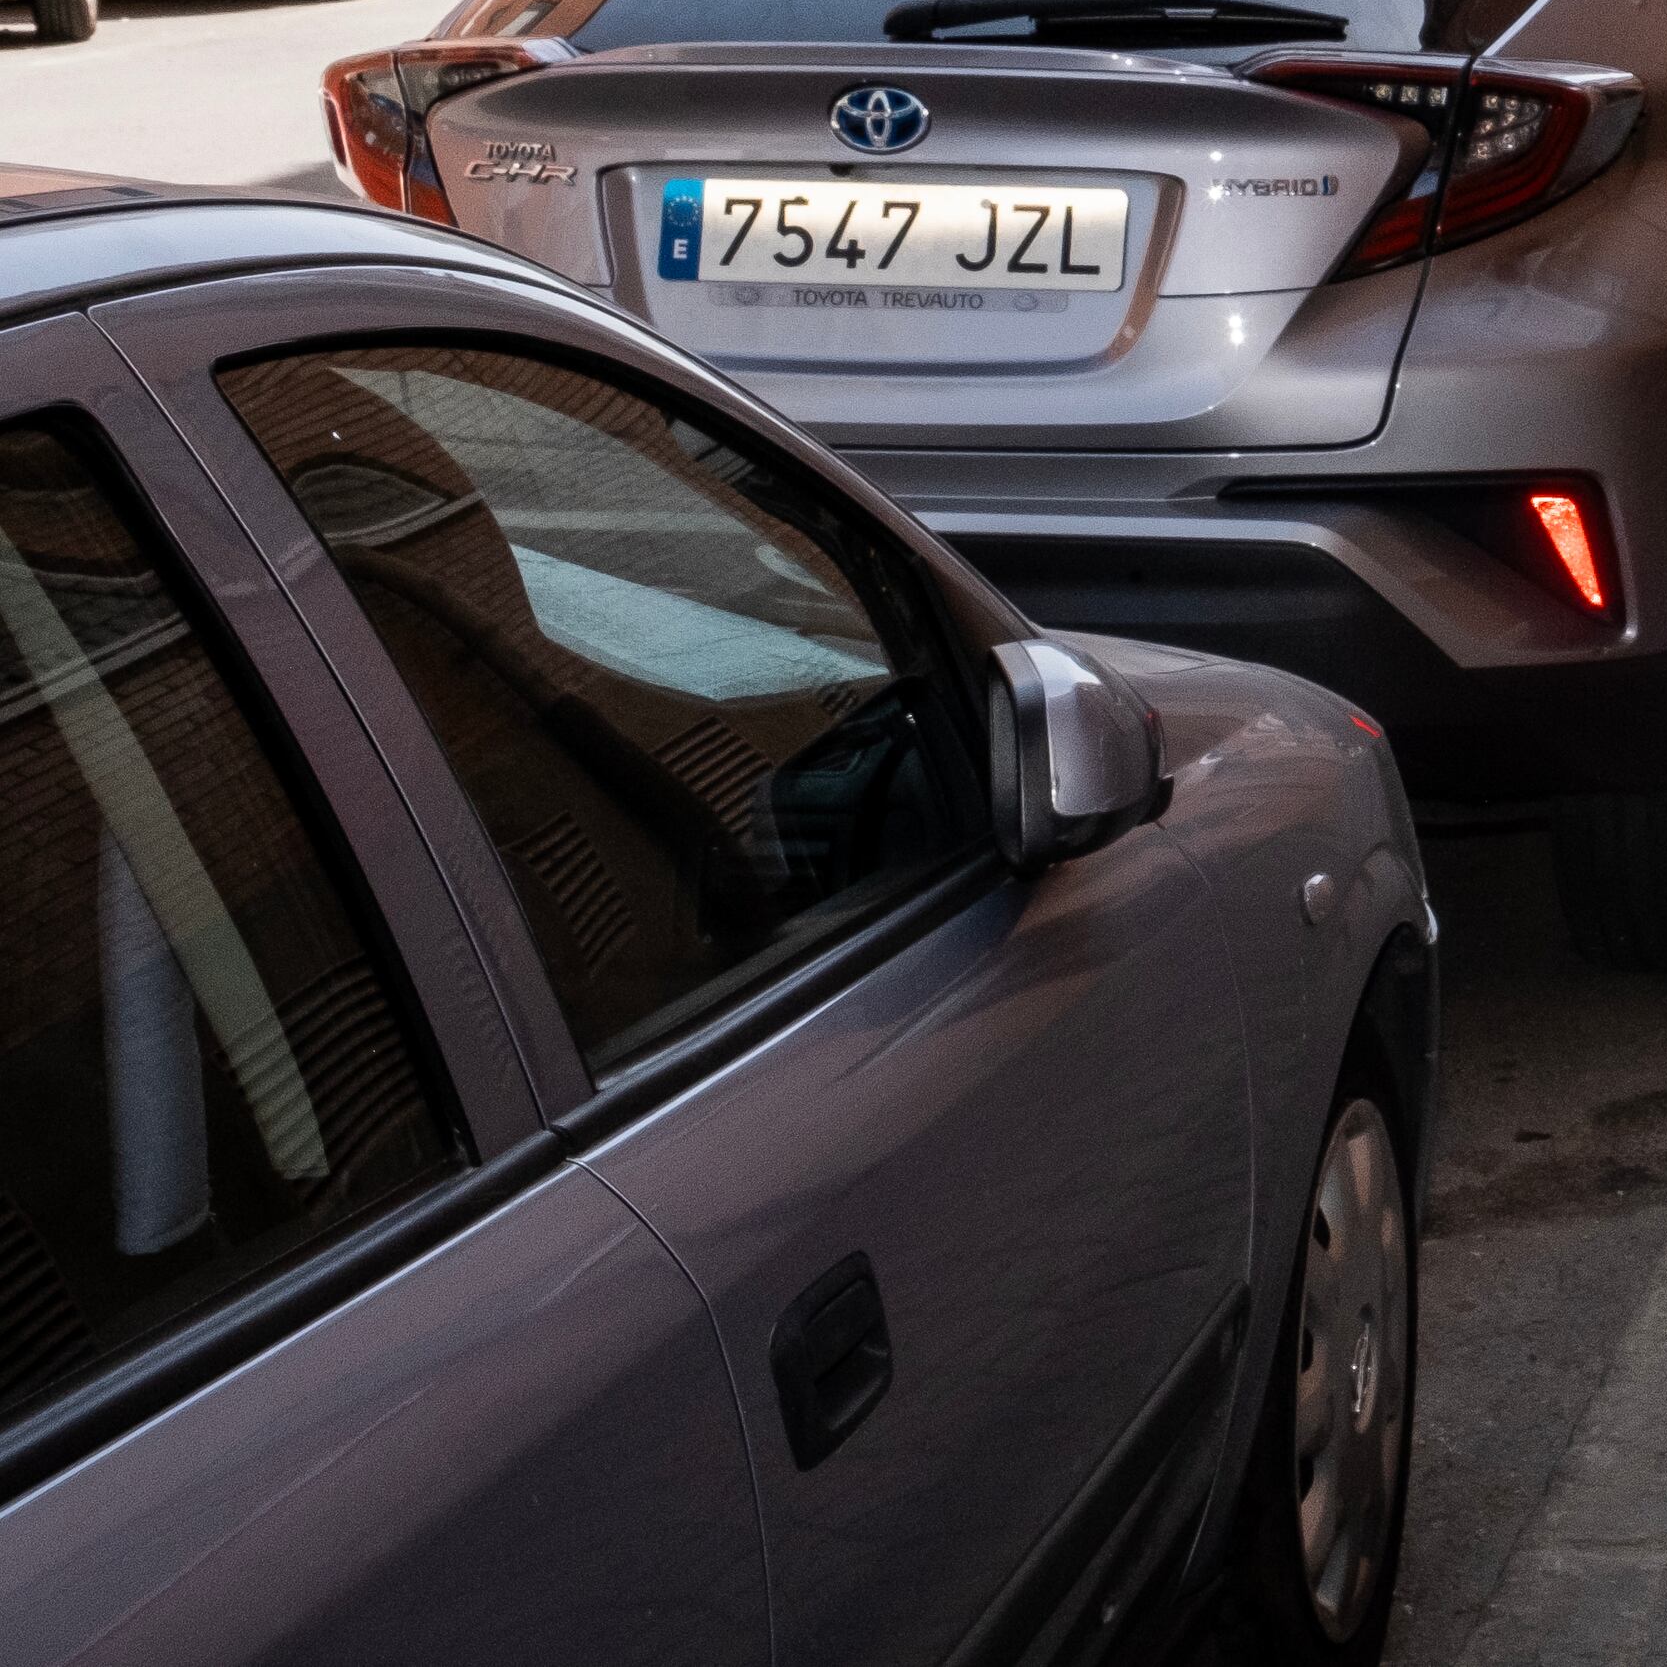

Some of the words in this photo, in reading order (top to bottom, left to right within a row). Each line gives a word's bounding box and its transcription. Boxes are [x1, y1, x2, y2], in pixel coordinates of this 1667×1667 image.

[482, 141, 556, 162] TOYOTA
[719, 196, 921, 270] 7547
[955, 199, 1100, 276] JZL
[794, 288, 867, 307] TOYOTA
[883, 291, 984, 311] TREVAUTO
